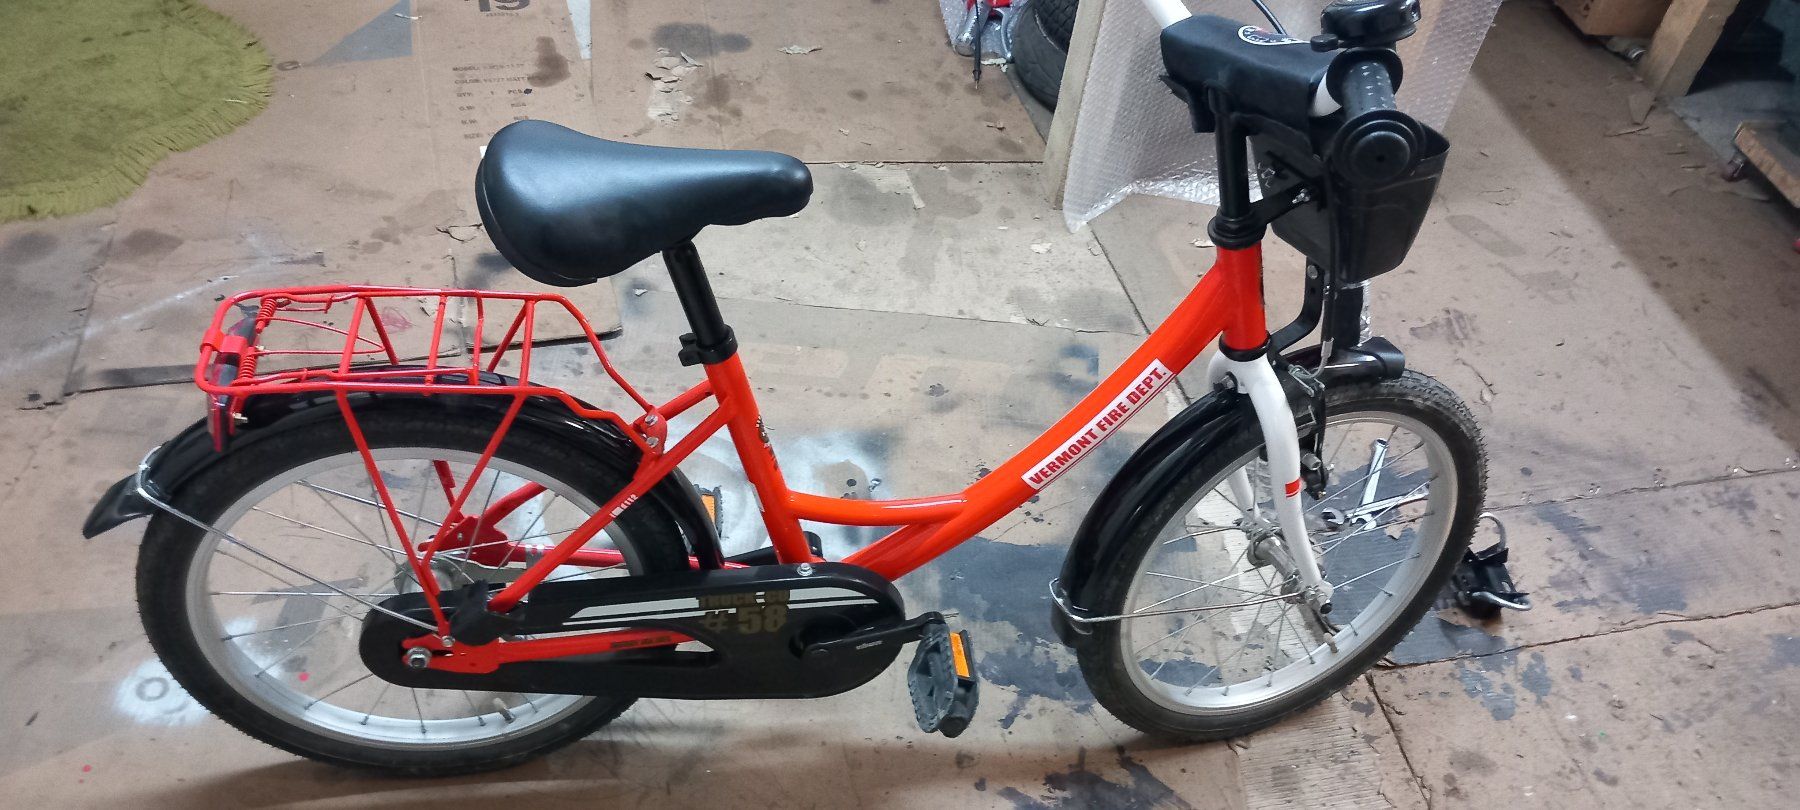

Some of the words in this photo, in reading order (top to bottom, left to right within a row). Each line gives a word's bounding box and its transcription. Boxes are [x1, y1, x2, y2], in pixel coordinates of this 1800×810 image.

[1029, 428, 1099, 485] VERMONT
[1096, 402, 1130, 432] FIRE
[1126, 367, 1167, 405] DEPT.
